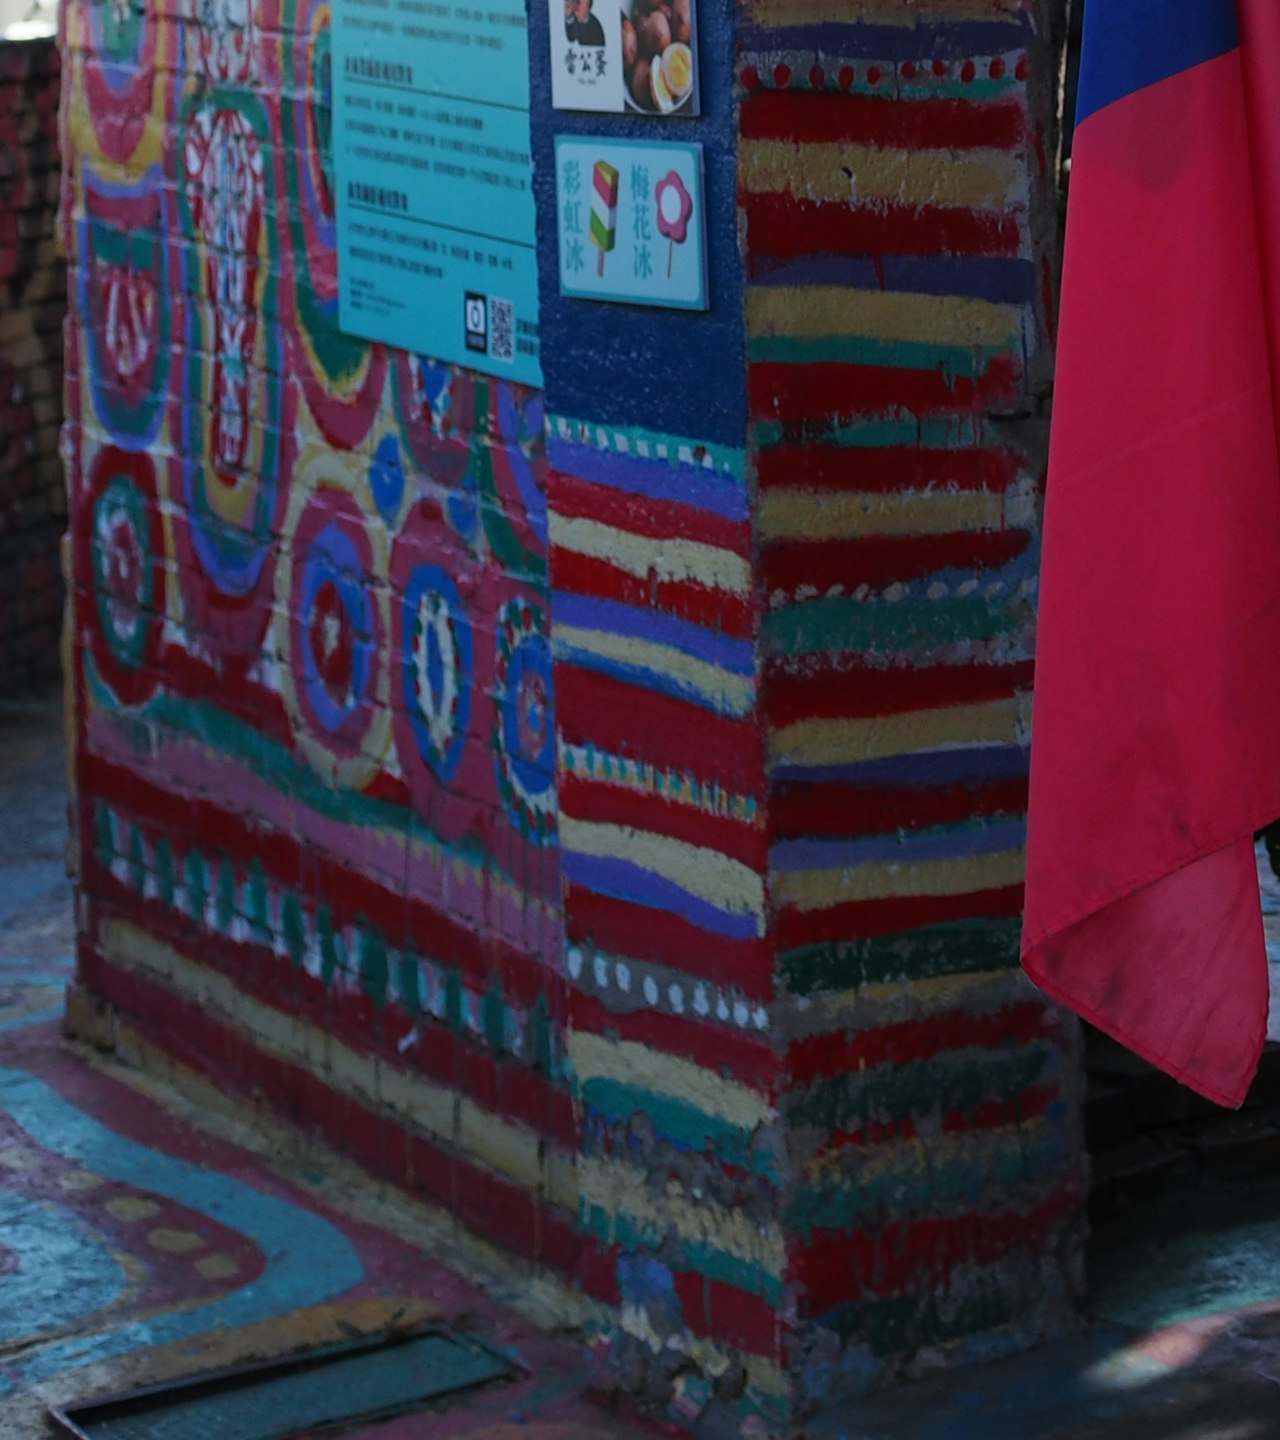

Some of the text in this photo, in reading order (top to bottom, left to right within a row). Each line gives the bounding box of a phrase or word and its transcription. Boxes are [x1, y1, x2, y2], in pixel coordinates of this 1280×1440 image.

[562, 160, 584, 274] 彩虹冰
[630, 163, 653, 279] 梅花冰
